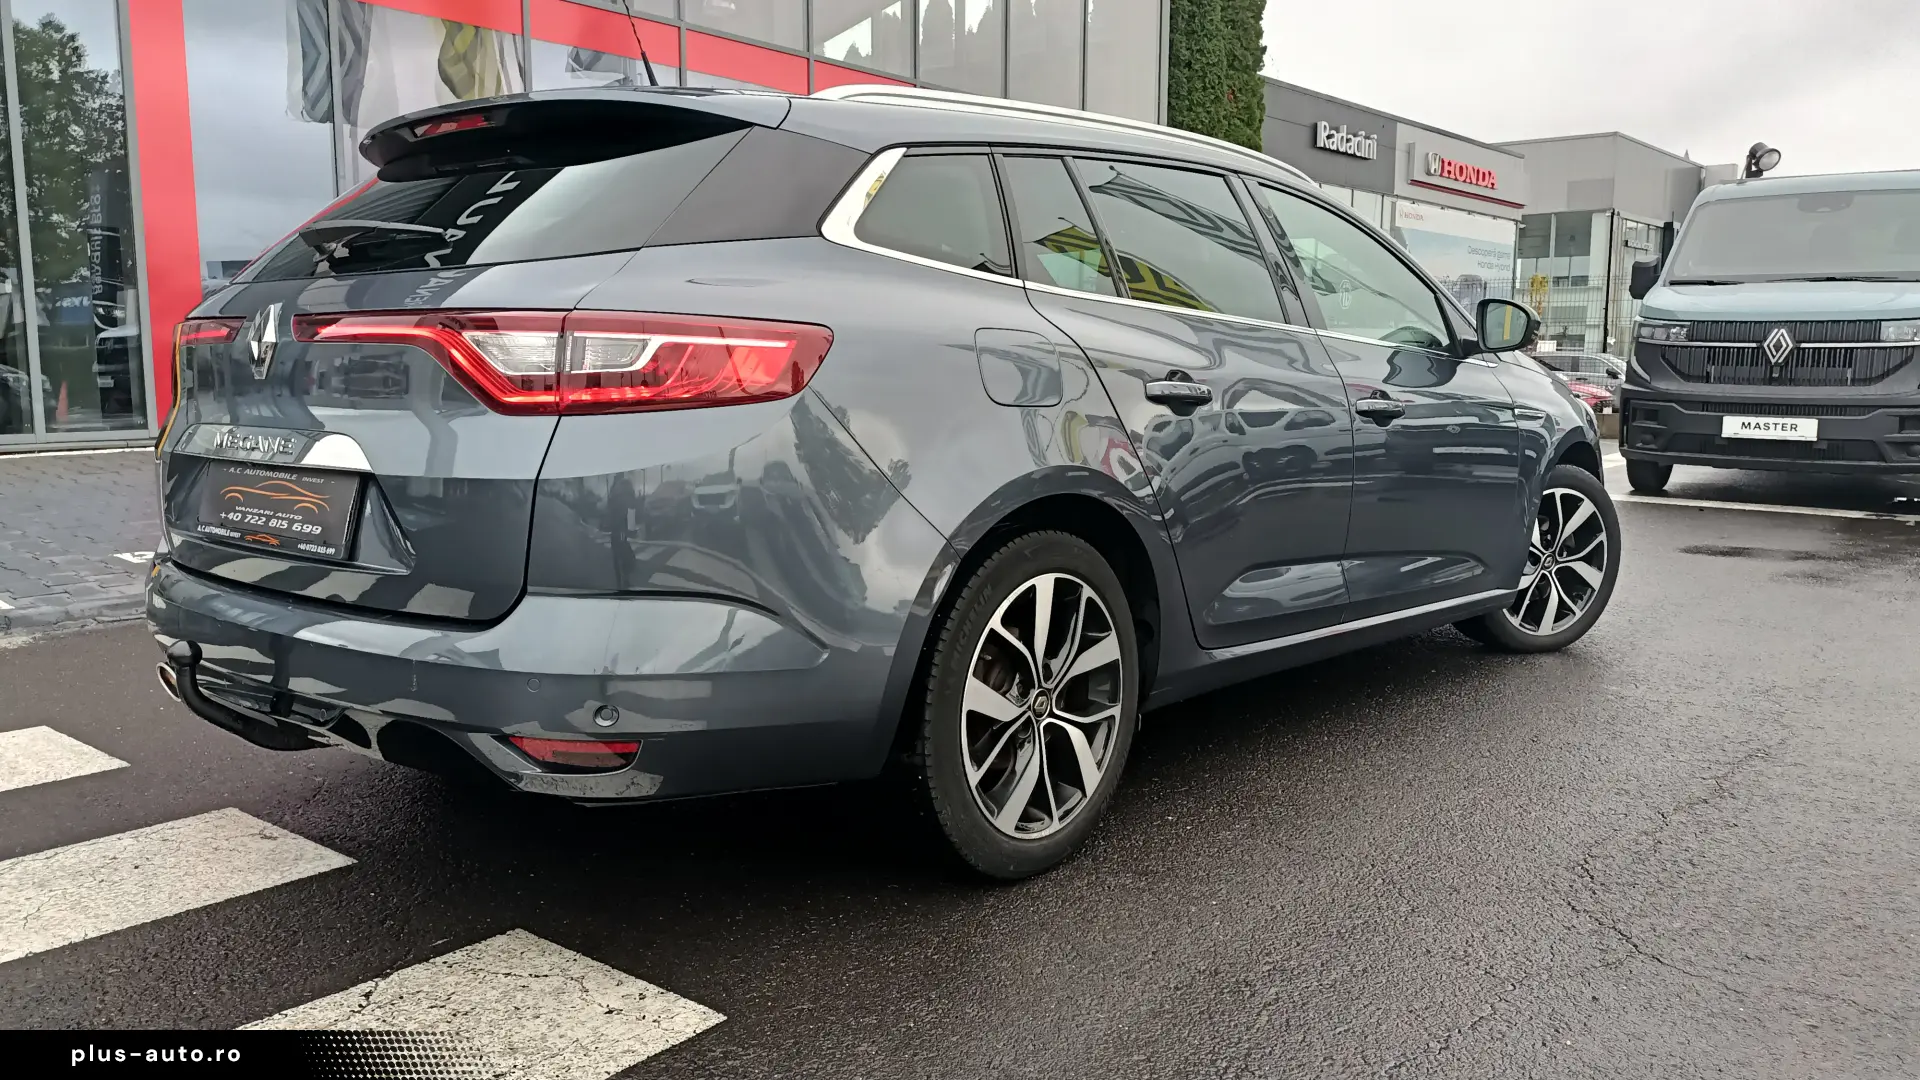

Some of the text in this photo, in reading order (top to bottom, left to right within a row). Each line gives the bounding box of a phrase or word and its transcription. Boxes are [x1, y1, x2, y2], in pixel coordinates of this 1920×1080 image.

[1316, 120, 1378, 160] Radacini
[1440, 157, 1498, 189] HONDA
[1404, 211, 1424, 221] HONDA
[1740, 421, 1798, 432] MASTER
[244, 468, 298, 481] AUTOMOBILE
[302, 476, 324, 484] INVEST
[235, 505, 303, 521] VANZARI AUTO
[220, 511, 322, 536] +40 722 815 699
[205, 527, 230, 537] AUTOMOBILE
